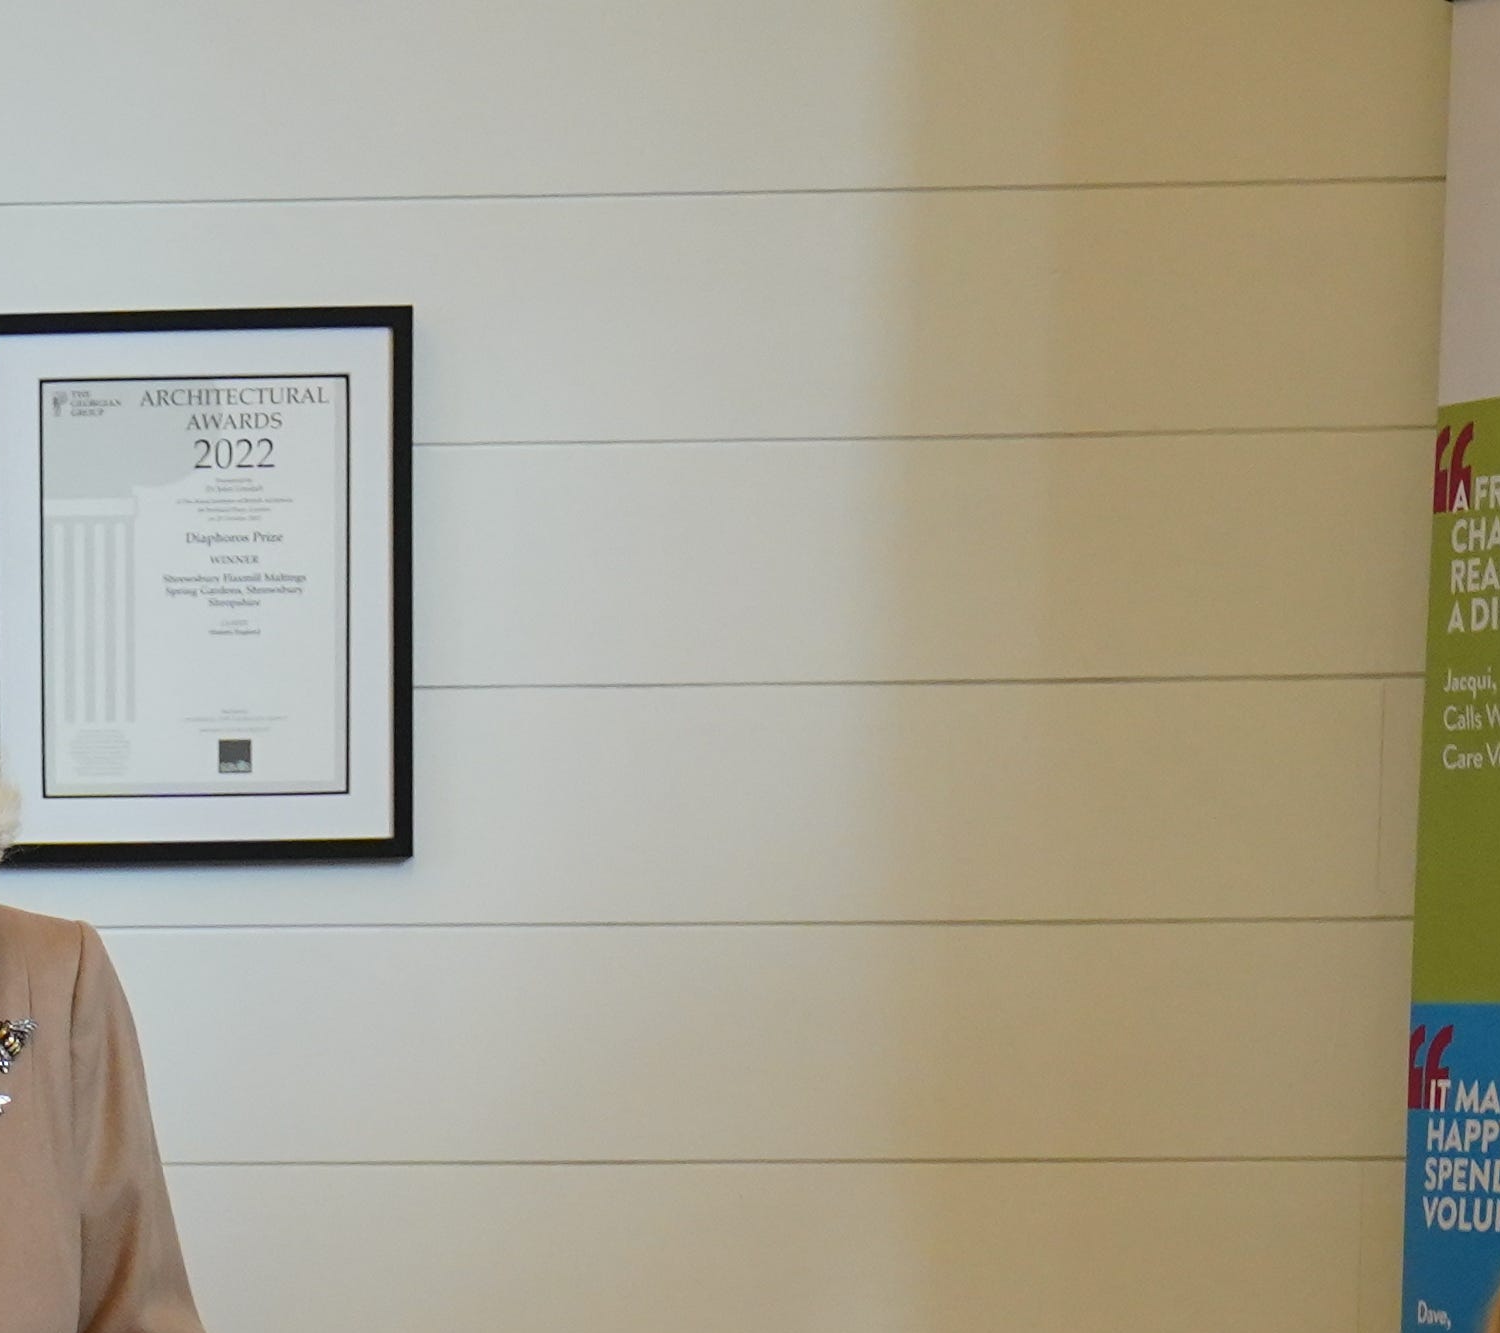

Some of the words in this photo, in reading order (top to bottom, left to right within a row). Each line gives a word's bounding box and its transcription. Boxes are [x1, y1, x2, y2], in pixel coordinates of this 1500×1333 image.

[139, 386, 330, 408] ARCHITECTURAL
[185, 411, 284, 431] AWARDS
[192, 437, 276, 470] 2022
[1452, 479, 1470, 513] A
[252, 531, 285, 544] Prize
[209, 555, 260, 565] WINNER
[1447, 598, 1465, 634] A
[1444, 666, 1498, 699] Jacqui,
[1443, 704, 1483, 732] Calls
[1442, 743, 1483, 771] Care
[1429, 1079, 1451, 1113] IT
[1417, 1299, 1452, 1331] Dave,
